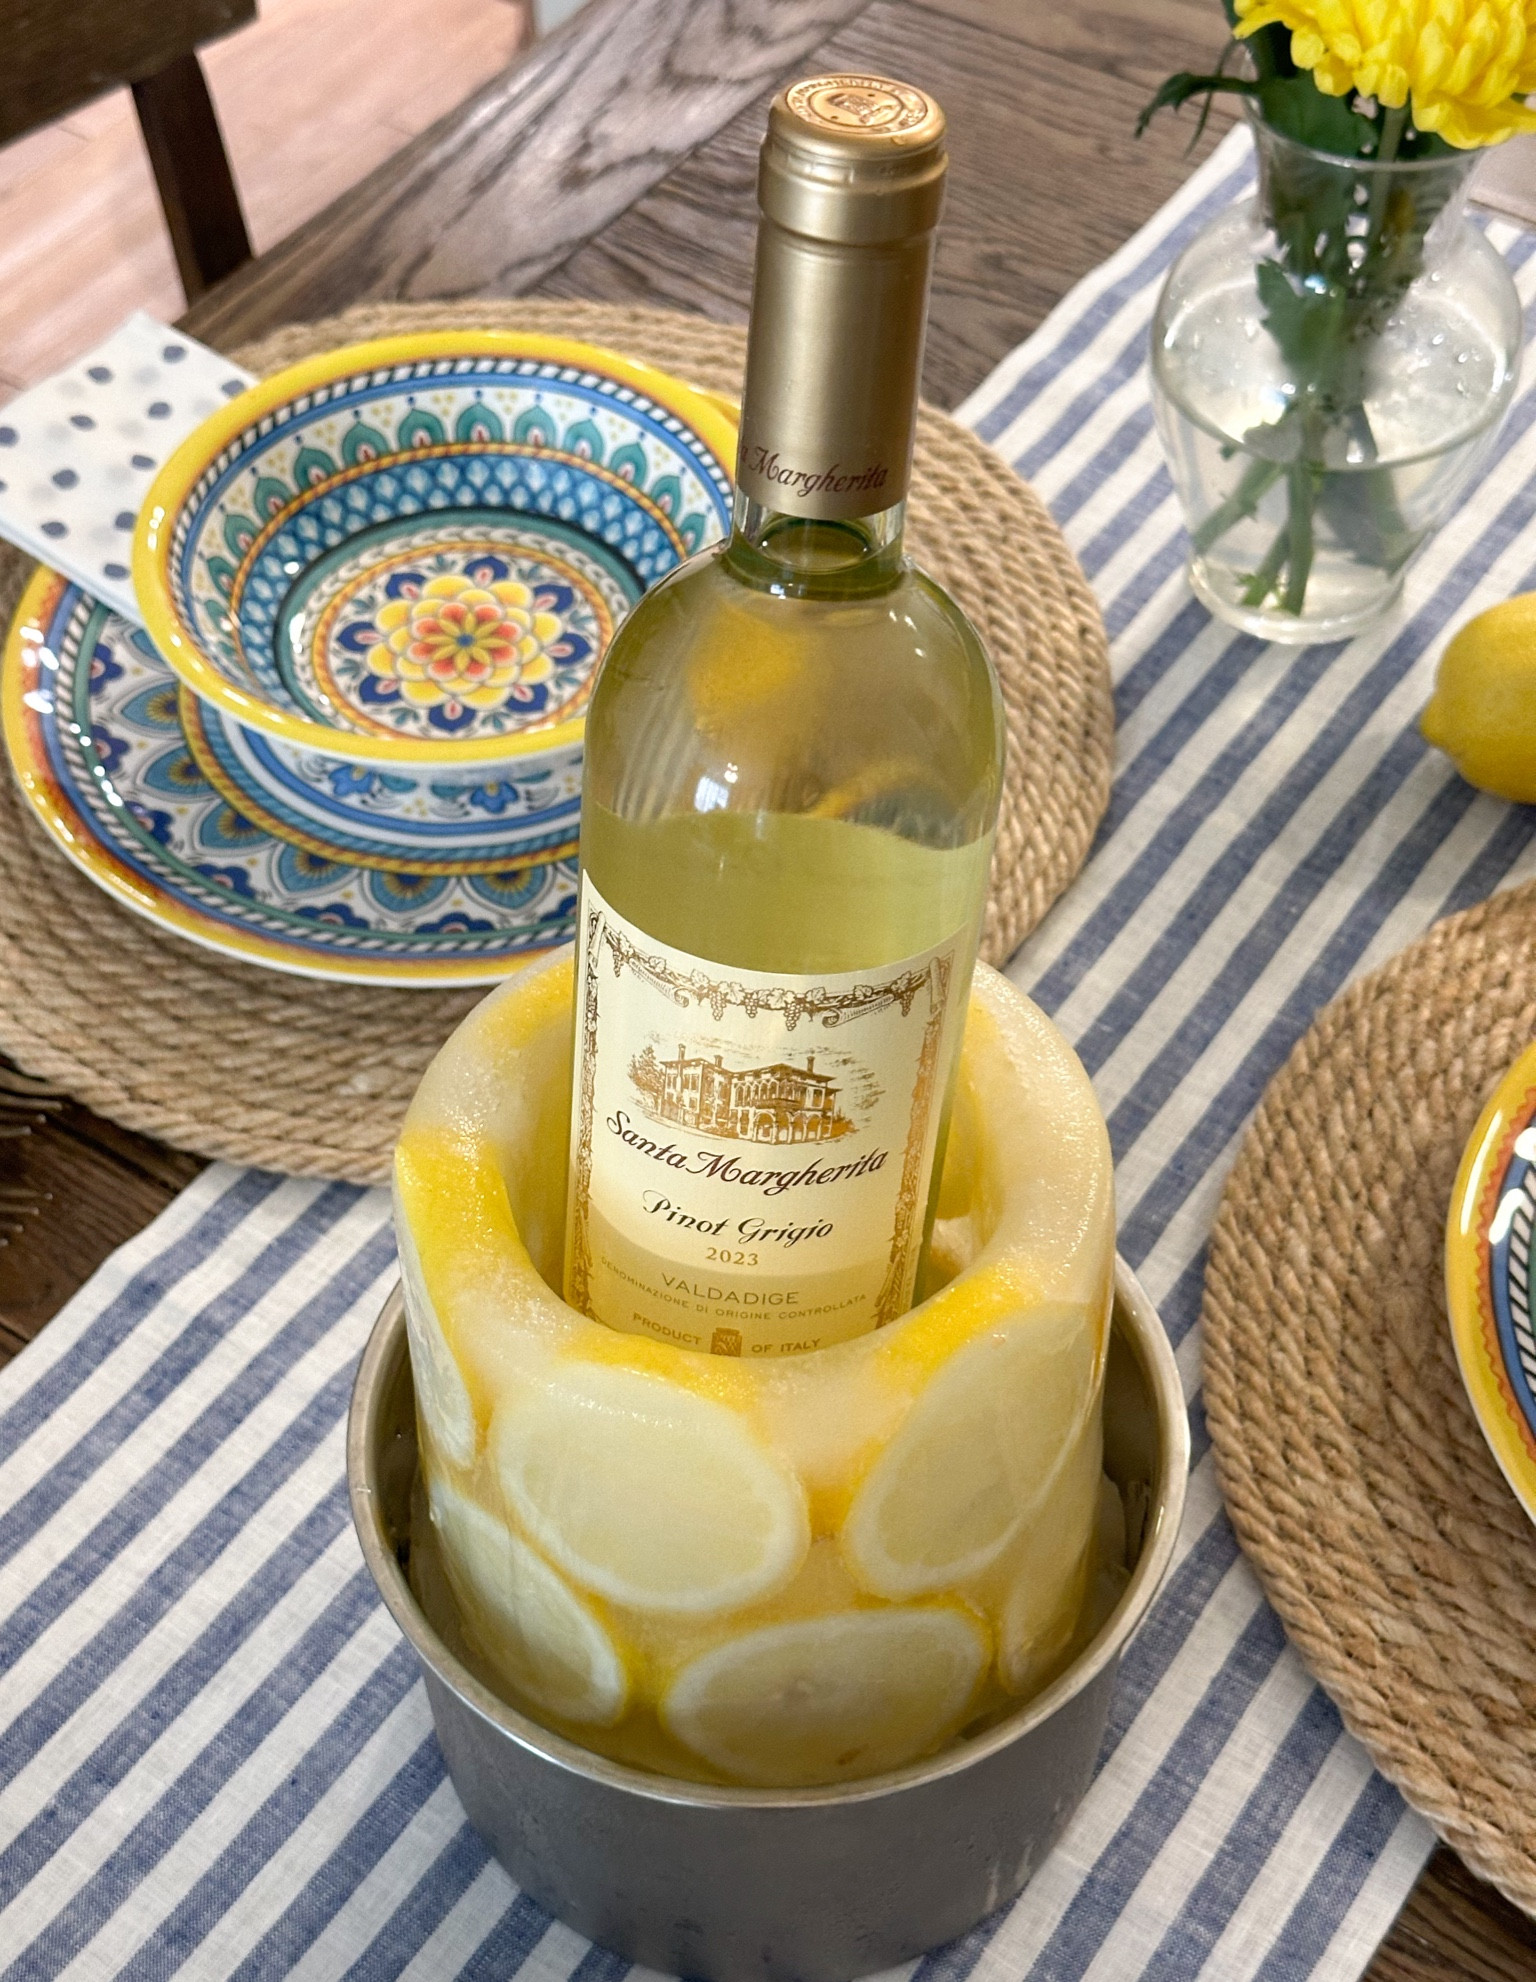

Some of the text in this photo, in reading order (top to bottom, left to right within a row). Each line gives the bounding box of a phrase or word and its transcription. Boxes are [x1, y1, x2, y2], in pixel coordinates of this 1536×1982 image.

[749, 447, 888, 497] Margherita
[606, 1110, 889, 1196] Santa Margherita
[642, 1190, 834, 1248] Pinot Grigio
[706, 1247, 759, 1267] 2023
[601, 1256, 866, 1320] DENOMINAZIONE DI ORIGINE CONTROLLATA
[661, 1273, 799, 1305] VALDADIGE
[632, 1312, 821, 1354] PRODUCT OF ITALY
